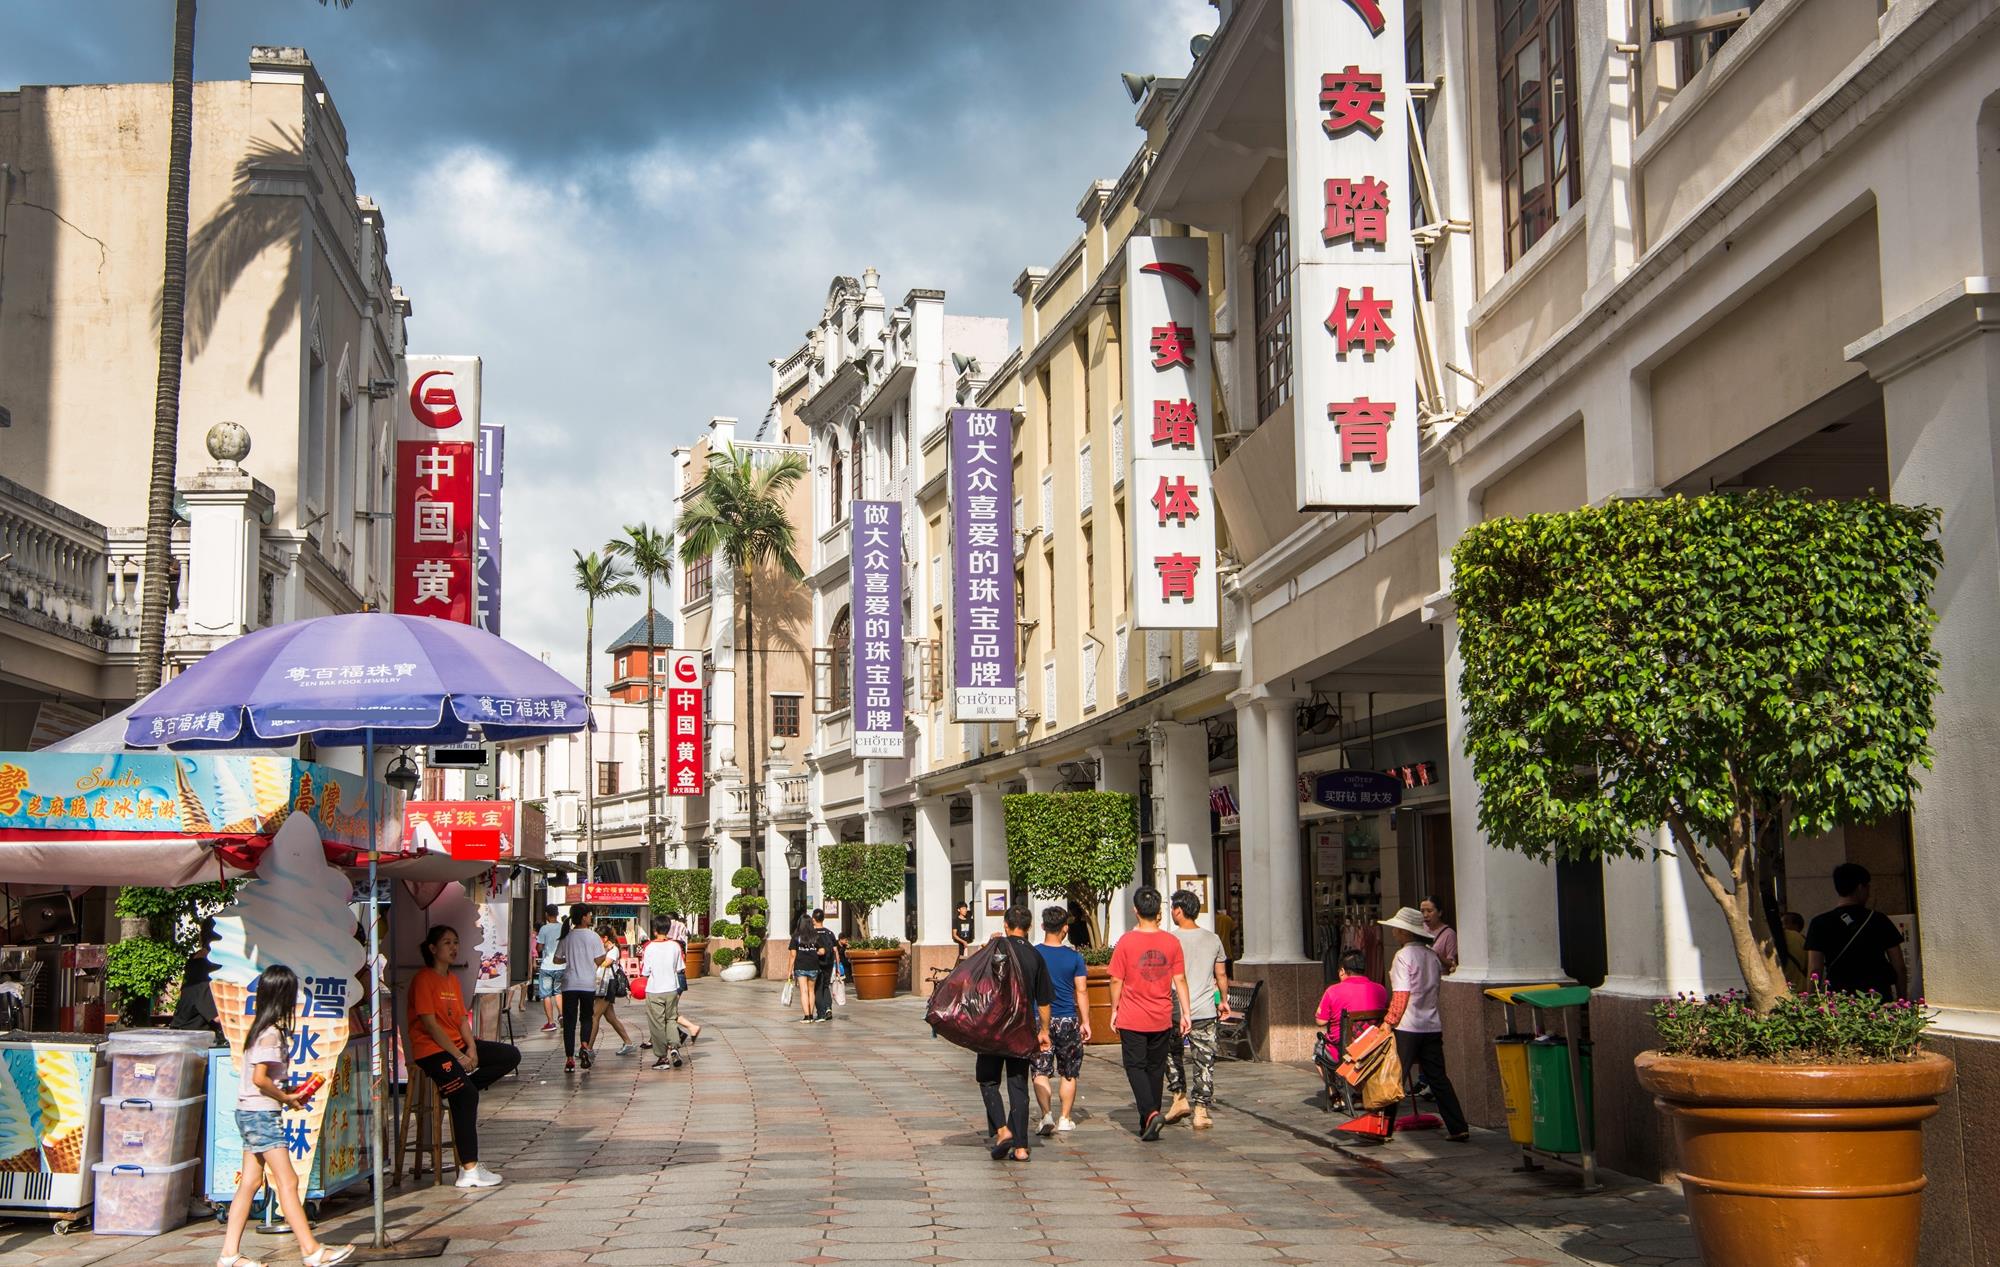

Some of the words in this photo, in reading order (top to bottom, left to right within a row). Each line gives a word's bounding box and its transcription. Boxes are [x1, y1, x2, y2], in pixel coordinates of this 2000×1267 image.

[1319, 65, 1397, 468] 安踏体育
[412, 448, 455, 620] 中国黄
[966, 412, 1001, 687] 做大众喜爱的珠宝品牌
[1150, 321, 1201, 602] 安踏体育
[863, 504, 892, 731] 做大众喜爱的珠宝品牌
[27, 795, 178, 819] 芝麻脆皮冰淇淋
[76, 767, 143, 791] Smile
[677, 691, 696, 787] 中国黄金
